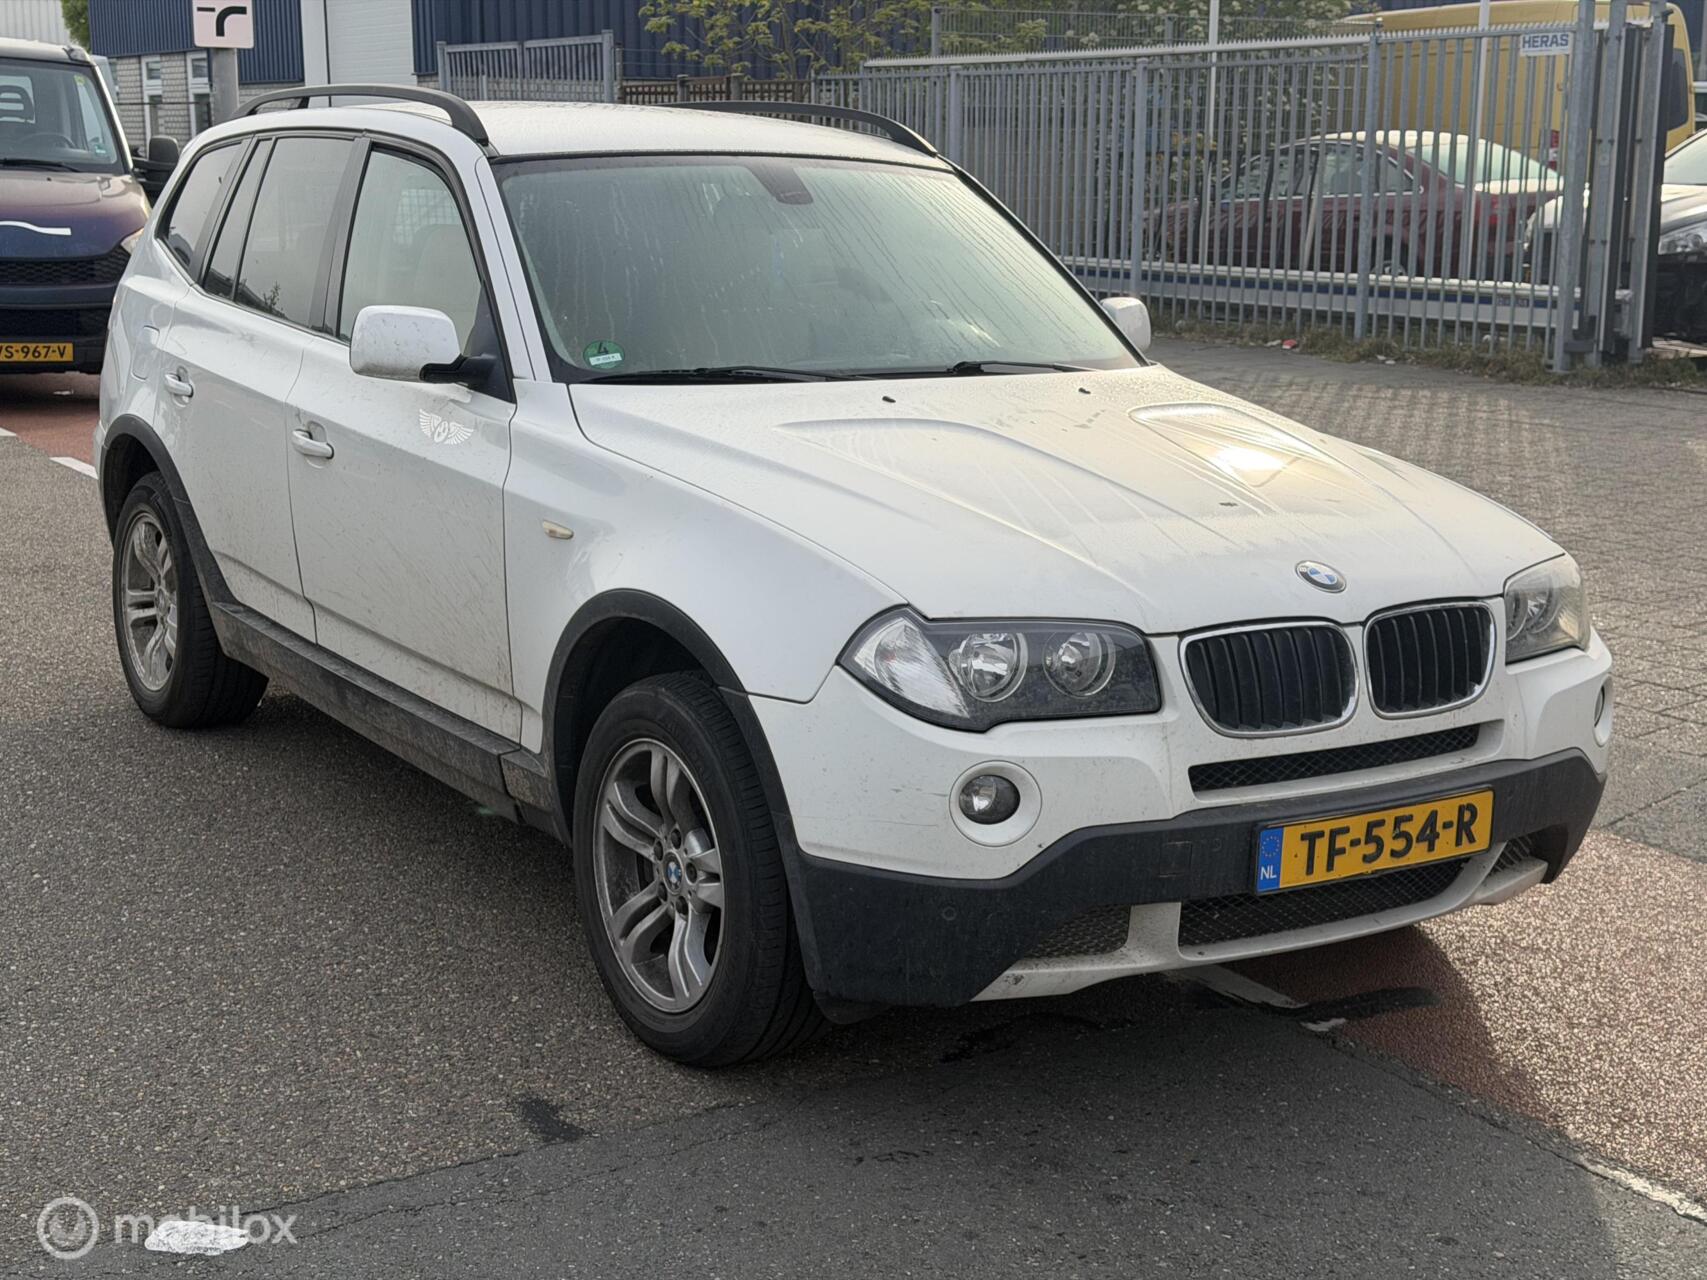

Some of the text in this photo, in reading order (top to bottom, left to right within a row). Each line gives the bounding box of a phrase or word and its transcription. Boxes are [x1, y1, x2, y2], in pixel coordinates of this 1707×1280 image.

[1522, 34, 1569, 48] HERAS
[0, 345, 66, 359] S-967-V
[1300, 802, 1478, 876] TF-554-R
[1260, 865, 1277, 880] NL
